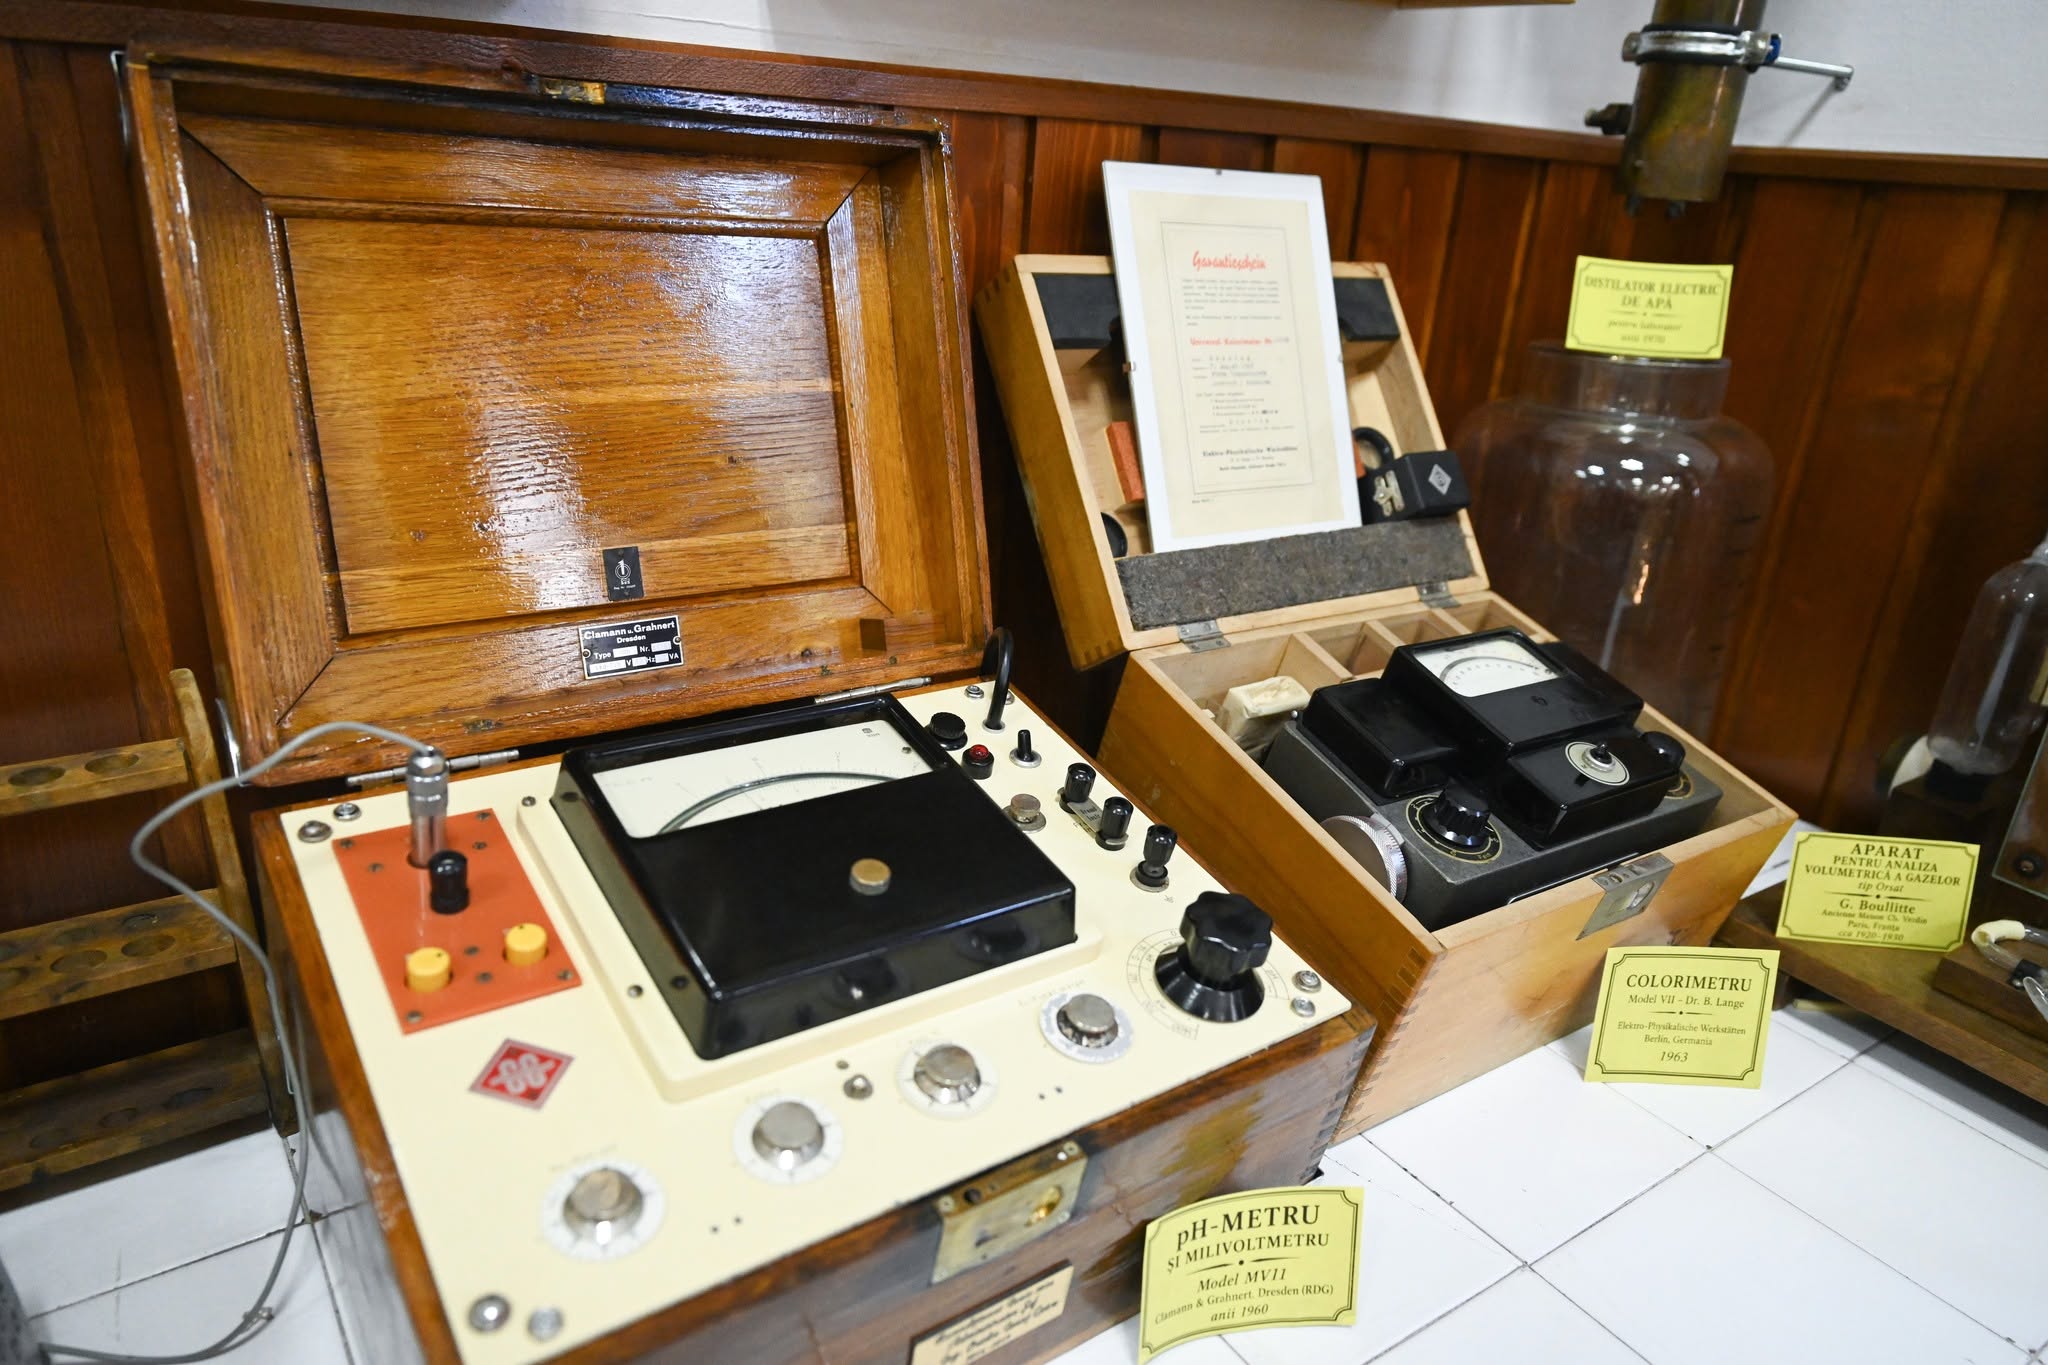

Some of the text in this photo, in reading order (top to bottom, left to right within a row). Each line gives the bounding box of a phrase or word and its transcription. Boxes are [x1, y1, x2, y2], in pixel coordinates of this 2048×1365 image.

[1584, 276, 1721, 296] DISTILATOR ELECTRIC
[1621, 295, 1641, 308] DE
[583, 628, 627, 640] Clamann
[633, 620, 675, 633] Grahnert
[616, 634, 647, 644] Dresden
[593, 645, 651, 660] Type Nr.
[669, 652, 679, 660] VA
[1851, 843, 1925, 860] APARAT
[1833, 855, 1938, 873] PENTRU ANALIZA
[1858, 882, 1904, 893] tip Orsat
[1894, 872, 1902, 881] A
[1906, 872, 1961, 886] GAZELOR
[1839, 898, 1916, 915] G. Boullitte
[1626, 974, 1752, 992] COLORIMETRU
[1628, 994, 1657, 1004] Model
[1661, 994, 1675, 1004] VII
[1685, 996, 1700, 1006] Dr.
[1704, 997, 1713, 1006] B.
[1716, 997, 1745, 1010] Lange
[1644, 1034, 1713, 1046] Berlin, Germania
[1660, 1051, 1689, 1063] 1963
[1177, 1204, 1321, 1251] pH-METRU
[1185, 1233, 1329, 1265] MILIVOLTMETRU
[1197, 1273, 1239, 1293] Model
[1155, 1303, 1193, 1324] Clamann
[1196, 1297, 1204, 1308] &
[1258, 1285, 1299, 1297] Dresden
[1301, 1284, 1334, 1296] (RDG)
[1211, 1303, 1269, 1321] anii 1960
